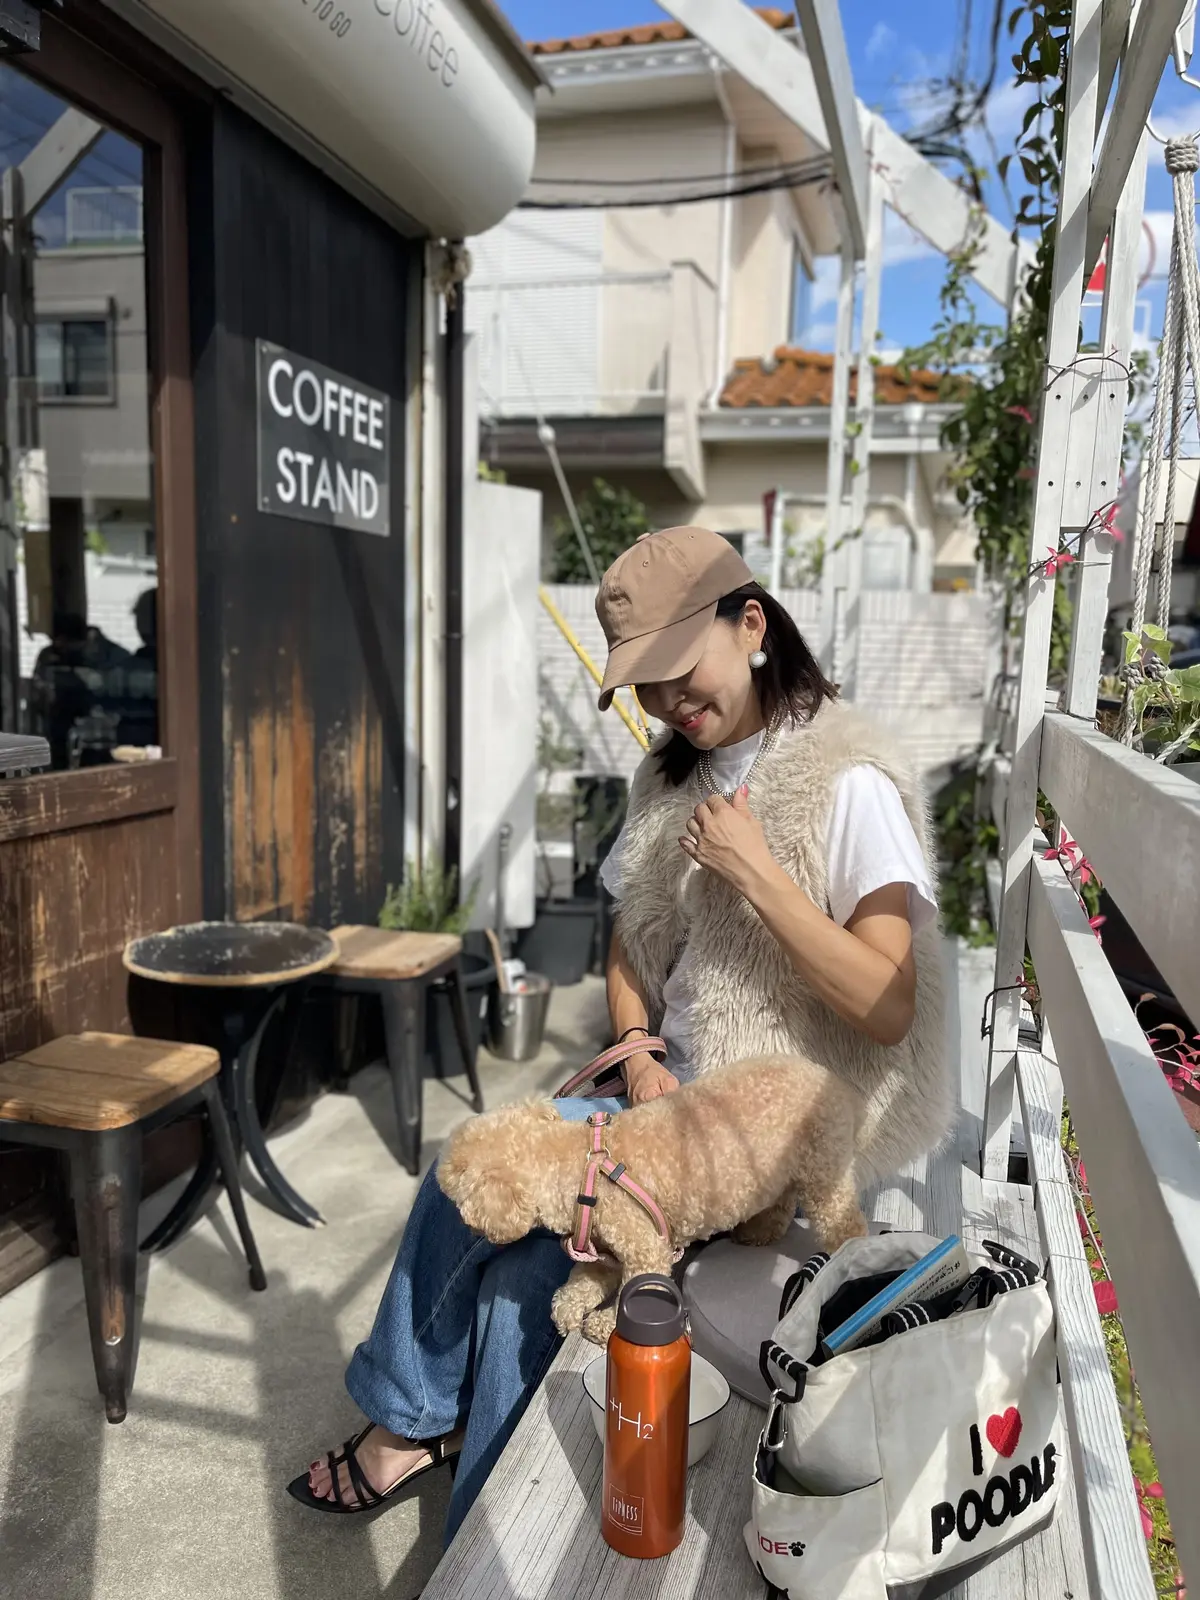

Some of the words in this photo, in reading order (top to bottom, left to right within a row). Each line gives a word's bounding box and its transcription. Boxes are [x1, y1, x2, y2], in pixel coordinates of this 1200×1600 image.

[329, 11, 352, 38] GO
[373, 0, 459, 87] offee
[267, 359, 383, 450] COFFEE
[276, 447, 380, 519] STAND
[969, 1423, 984, 1476] I
